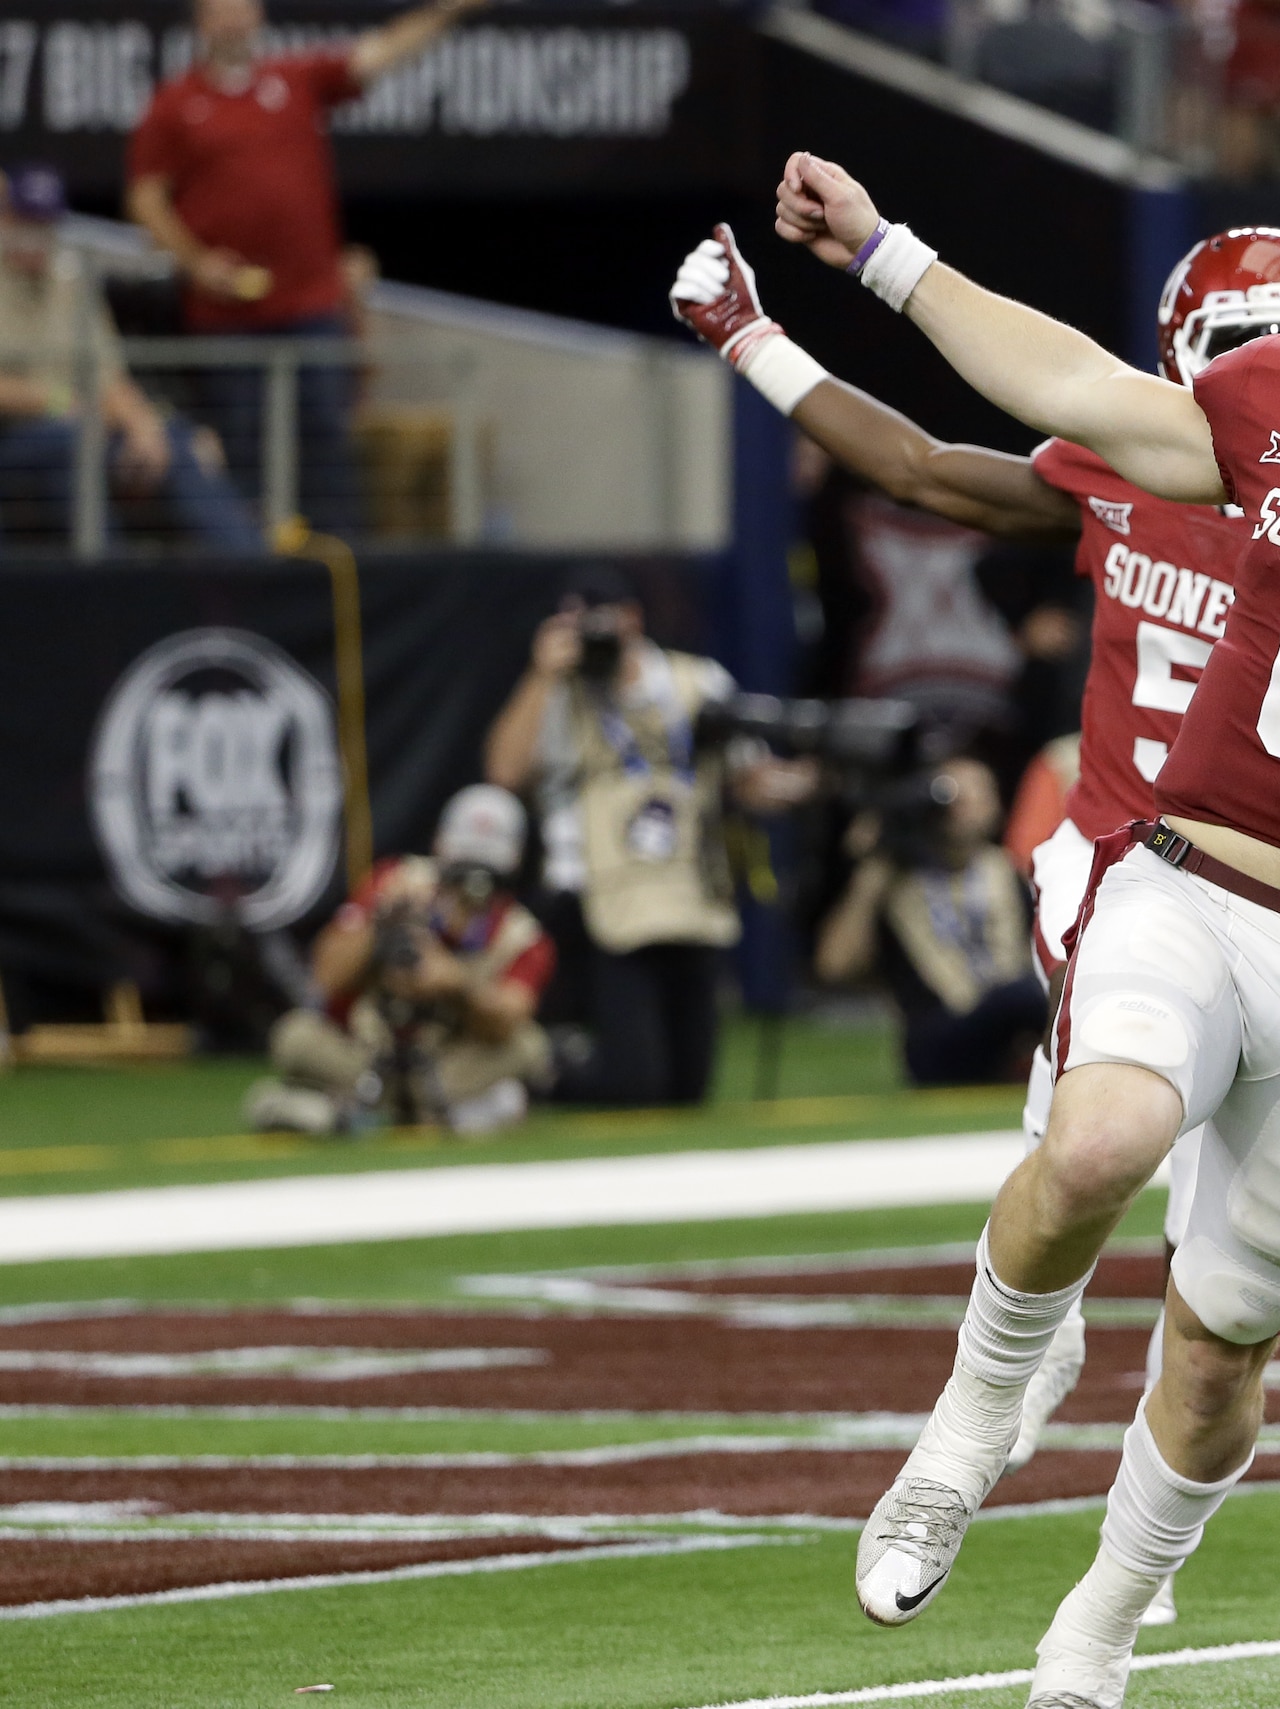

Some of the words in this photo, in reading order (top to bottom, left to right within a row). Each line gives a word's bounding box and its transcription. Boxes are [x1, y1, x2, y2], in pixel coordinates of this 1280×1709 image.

[46, 20, 153, 133] BIG
[148, 689, 292, 815] FOX
[1131, 620, 1215, 784] 5
